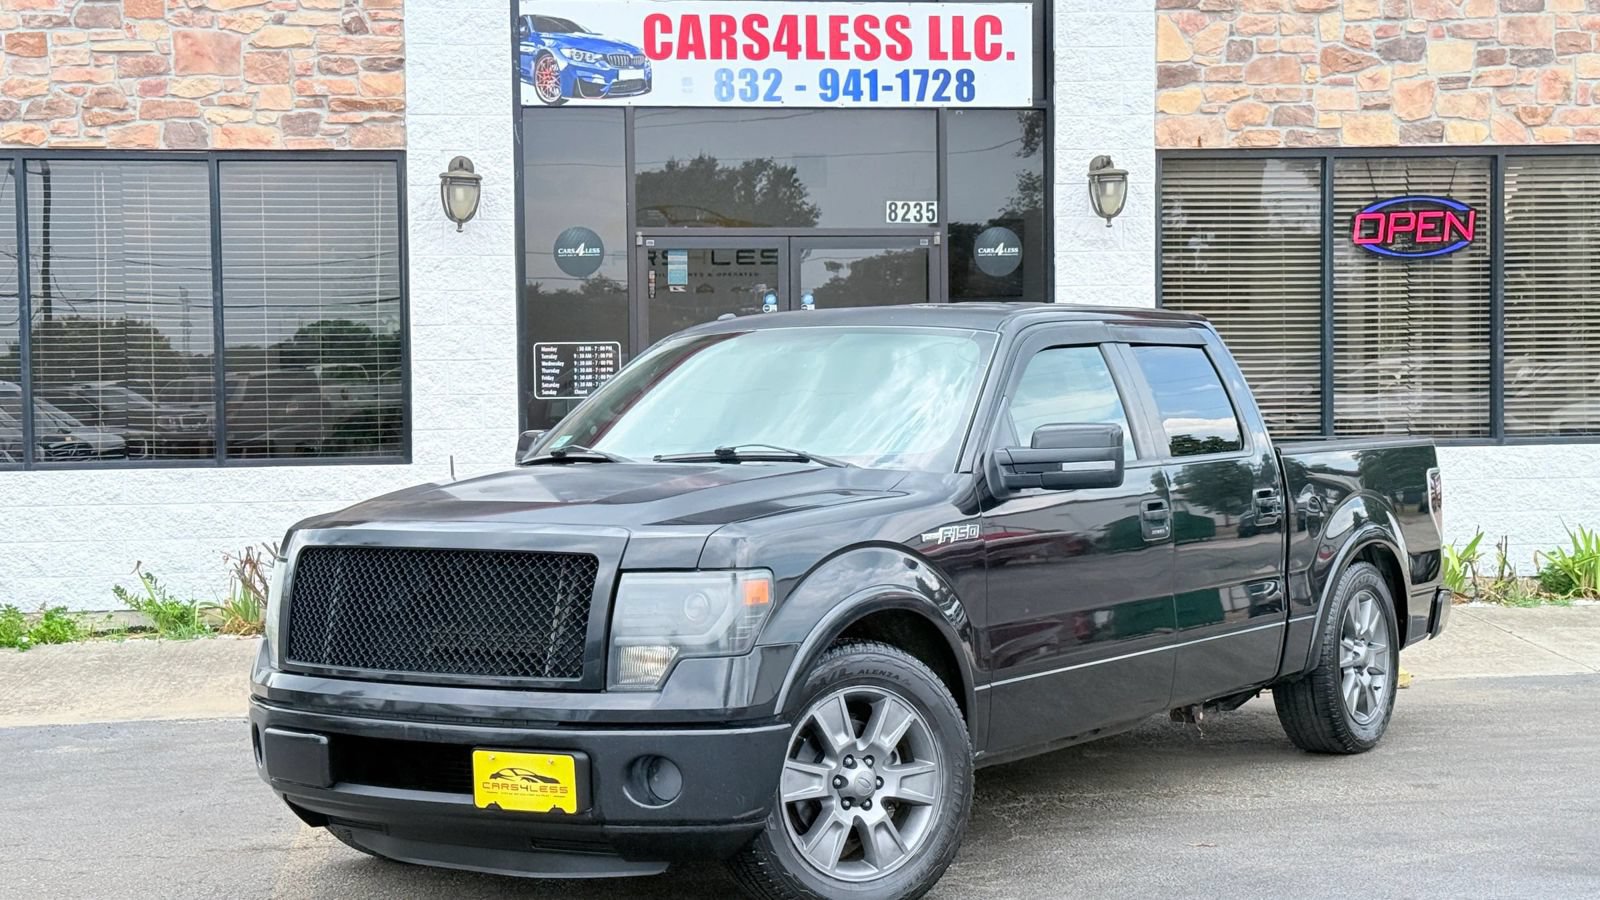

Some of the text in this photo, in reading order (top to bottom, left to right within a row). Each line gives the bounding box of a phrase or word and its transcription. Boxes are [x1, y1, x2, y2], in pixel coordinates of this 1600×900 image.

[643, 13, 1015, 61] CARS4LESS LLC.
[714, 68, 783, 102] 832
[818, 68, 976, 102] 941-1728
[888, 202, 936, 222] 8235
[1353, 210, 1476, 244] OPEN
[482, 781, 568, 794] CARS4LESS
